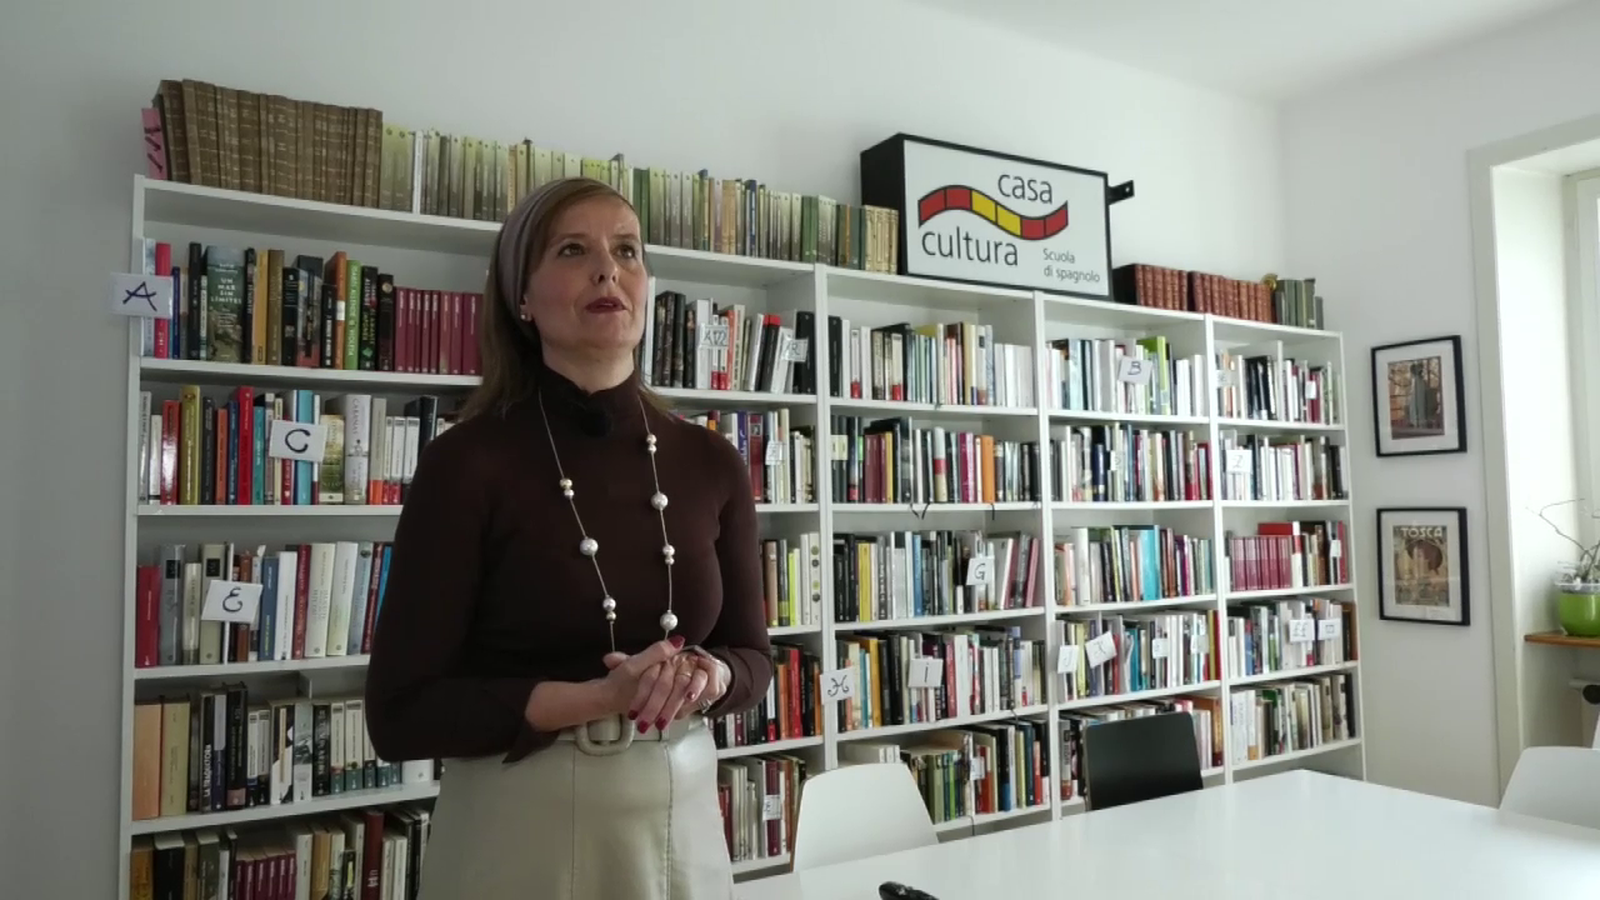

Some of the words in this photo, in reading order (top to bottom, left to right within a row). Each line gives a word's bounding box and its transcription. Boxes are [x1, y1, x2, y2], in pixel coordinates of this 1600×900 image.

[998, 174, 1053, 204] casa
[922, 226, 1018, 266] cultura
[1043, 248, 1076, 264] Scuola
[1044, 263, 1055, 278] di
[1056, 268, 1101, 284] spagnolo
[122, 281, 158, 312] A
[347, 329, 356, 356] VIOLETA
[284, 428, 312, 455] C
[1400, 526, 1443, 539] TOSCA
[974, 562, 986, 581] G
